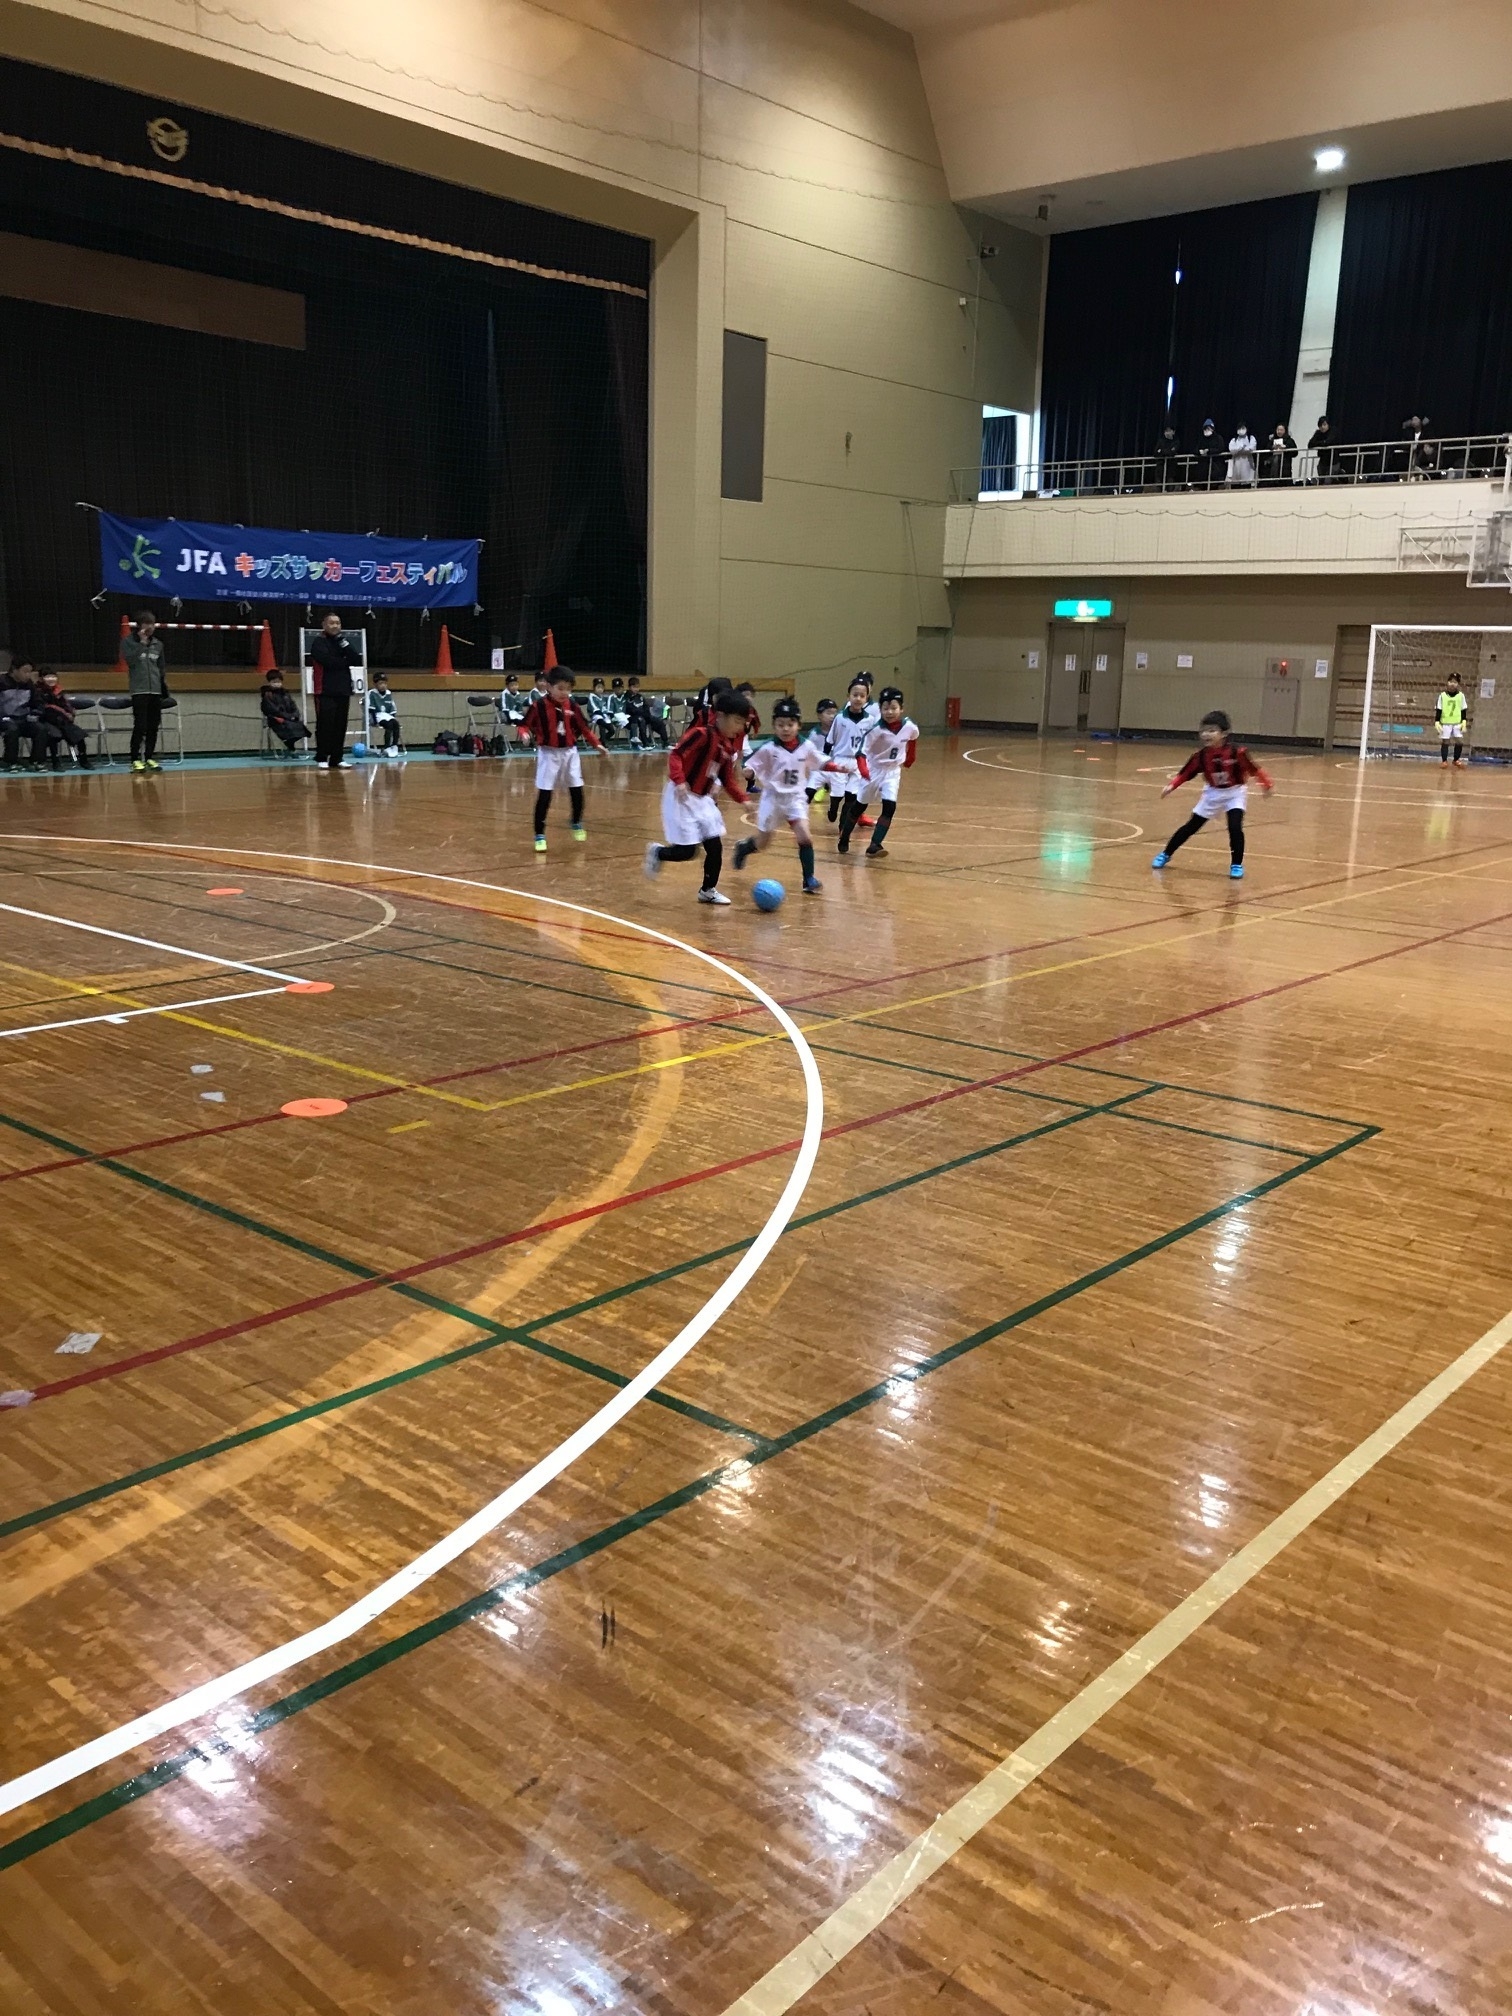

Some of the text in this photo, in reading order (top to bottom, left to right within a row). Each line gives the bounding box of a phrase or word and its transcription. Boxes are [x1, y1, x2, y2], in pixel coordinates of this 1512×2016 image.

[176, 548, 468, 586] JFA キッズサッカーフェスティバル
[1447, 700, 1457, 717] 7
[783, 769, 799, 785] 15
